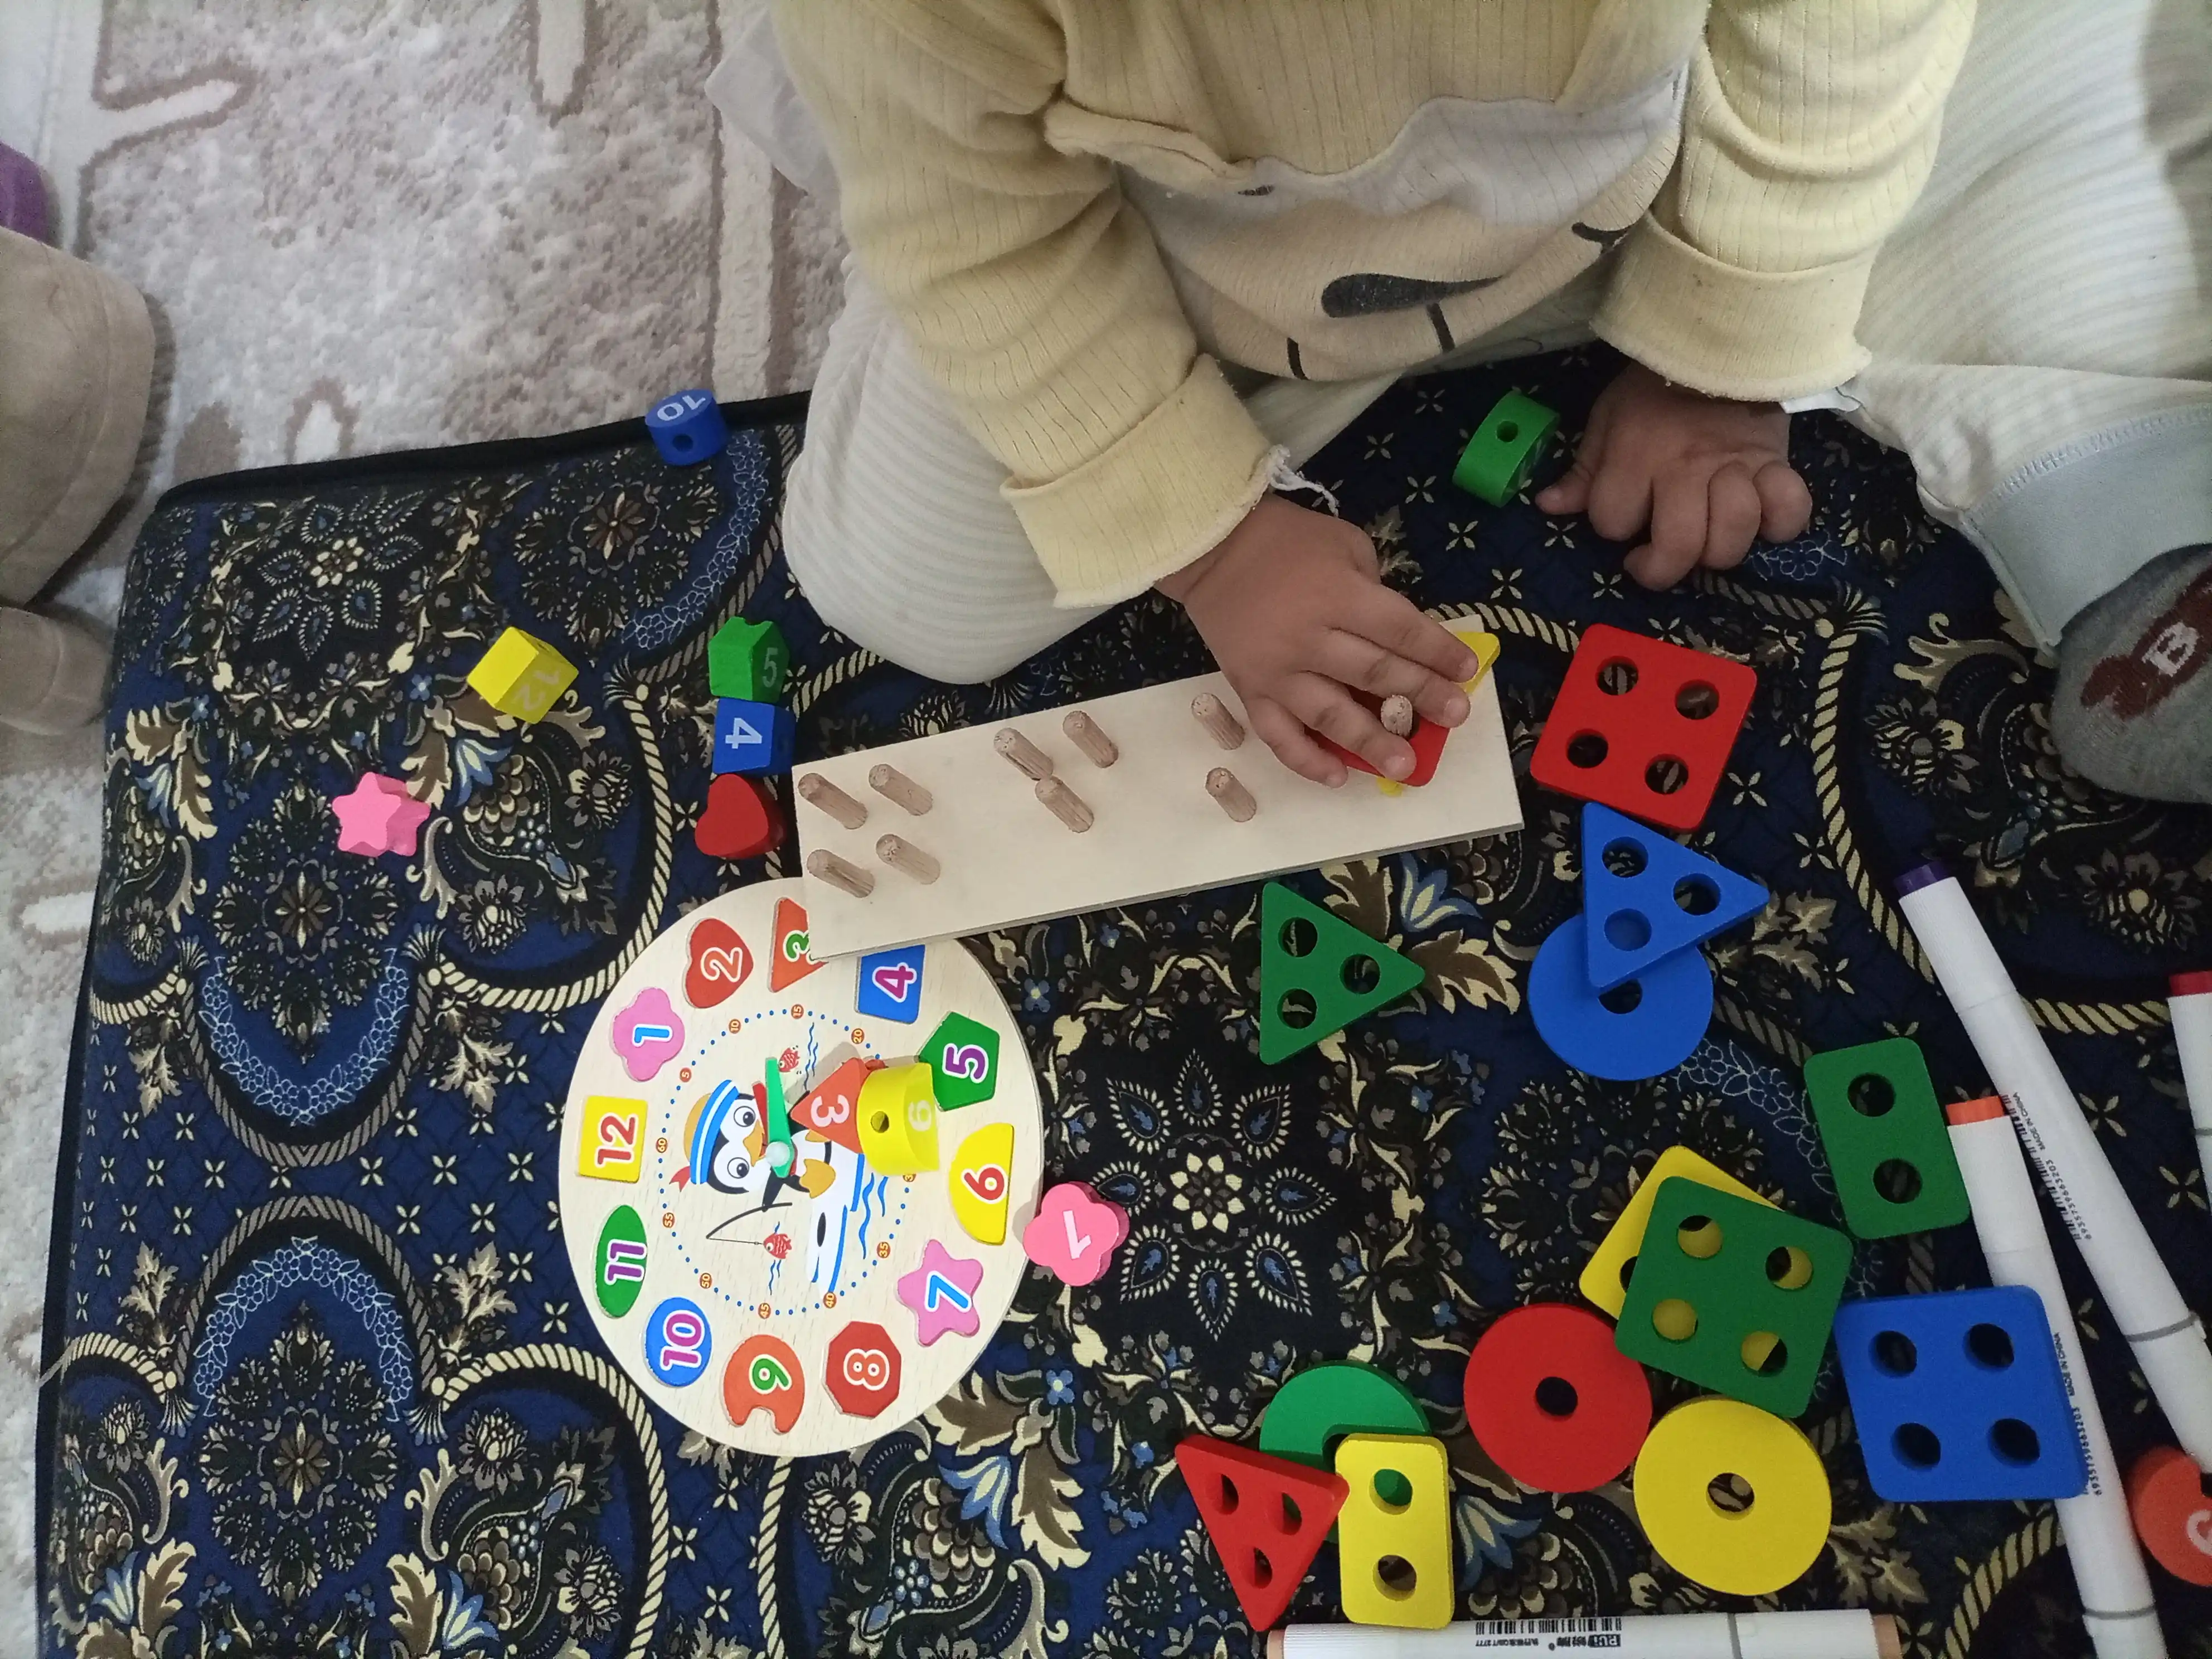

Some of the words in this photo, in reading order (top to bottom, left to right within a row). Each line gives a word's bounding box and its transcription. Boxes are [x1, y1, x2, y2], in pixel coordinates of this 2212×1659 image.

[657, 395, 706, 421] 10
[762, 647, 779, 688] 5
[511, 670, 560, 711] 12
[725, 717, 762, 749] 4
[700, 947, 744, 983] 2
[871, 961, 918, 1002] 4
[731, 1021, 739, 1031] 10
[793, 1006, 802, 1017] 15
[633, 1023, 673, 1049] 1
[853, 1030, 862, 1043] 20
[942, 1043, 989, 1083] 5
[811, 1094, 850, 1127] 3
[2012, 1092, 2029, 1117] CHINA
[2026, 1117, 2034, 1127] IN
[2029, 1125, 2046, 1151] MADE
[595, 1113, 637, 1167] 12
[658, 1139, 667, 1152] 60
[963, 1164, 1011, 1204] 6
[664, 1213, 673, 1227] 55
[1063, 1210, 1092, 1260] 1
[604, 1238, 648, 1287] 11
[879, 1243, 889, 1257] 35
[701, 1275, 710, 1288] 50
[924, 1273, 973, 1314] 7
[760, 1304, 769, 1317] 45
[826, 1294, 835, 1307] 40
[662, 1312, 706, 1372] 10
[748, 1354, 793, 1395] 9
[843, 1347, 890, 1389] 8
